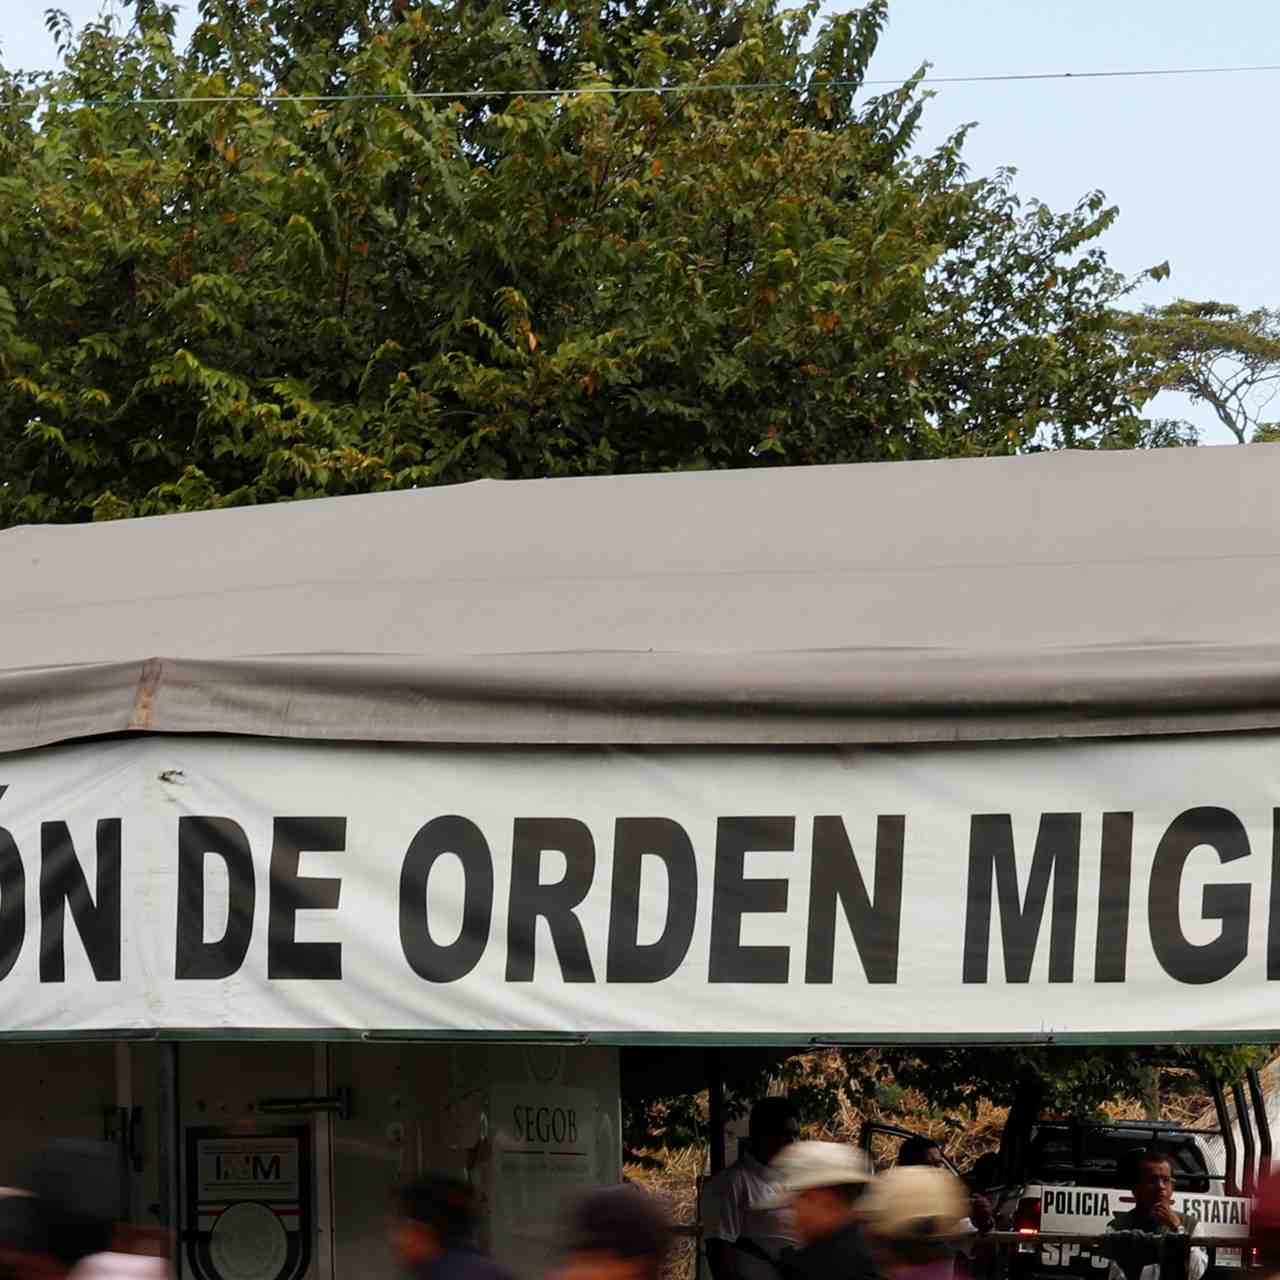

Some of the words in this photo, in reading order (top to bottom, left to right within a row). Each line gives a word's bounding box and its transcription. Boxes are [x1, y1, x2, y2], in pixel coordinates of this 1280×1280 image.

[174, 814, 348, 981] DE
[399, 813, 906, 985] ORDEN
[513, 1105, 577, 1143] SEGOB
[1044, 1190, 1110, 1217] POLICIA
[1183, 1198, 1249, 1225] ESTATAL
